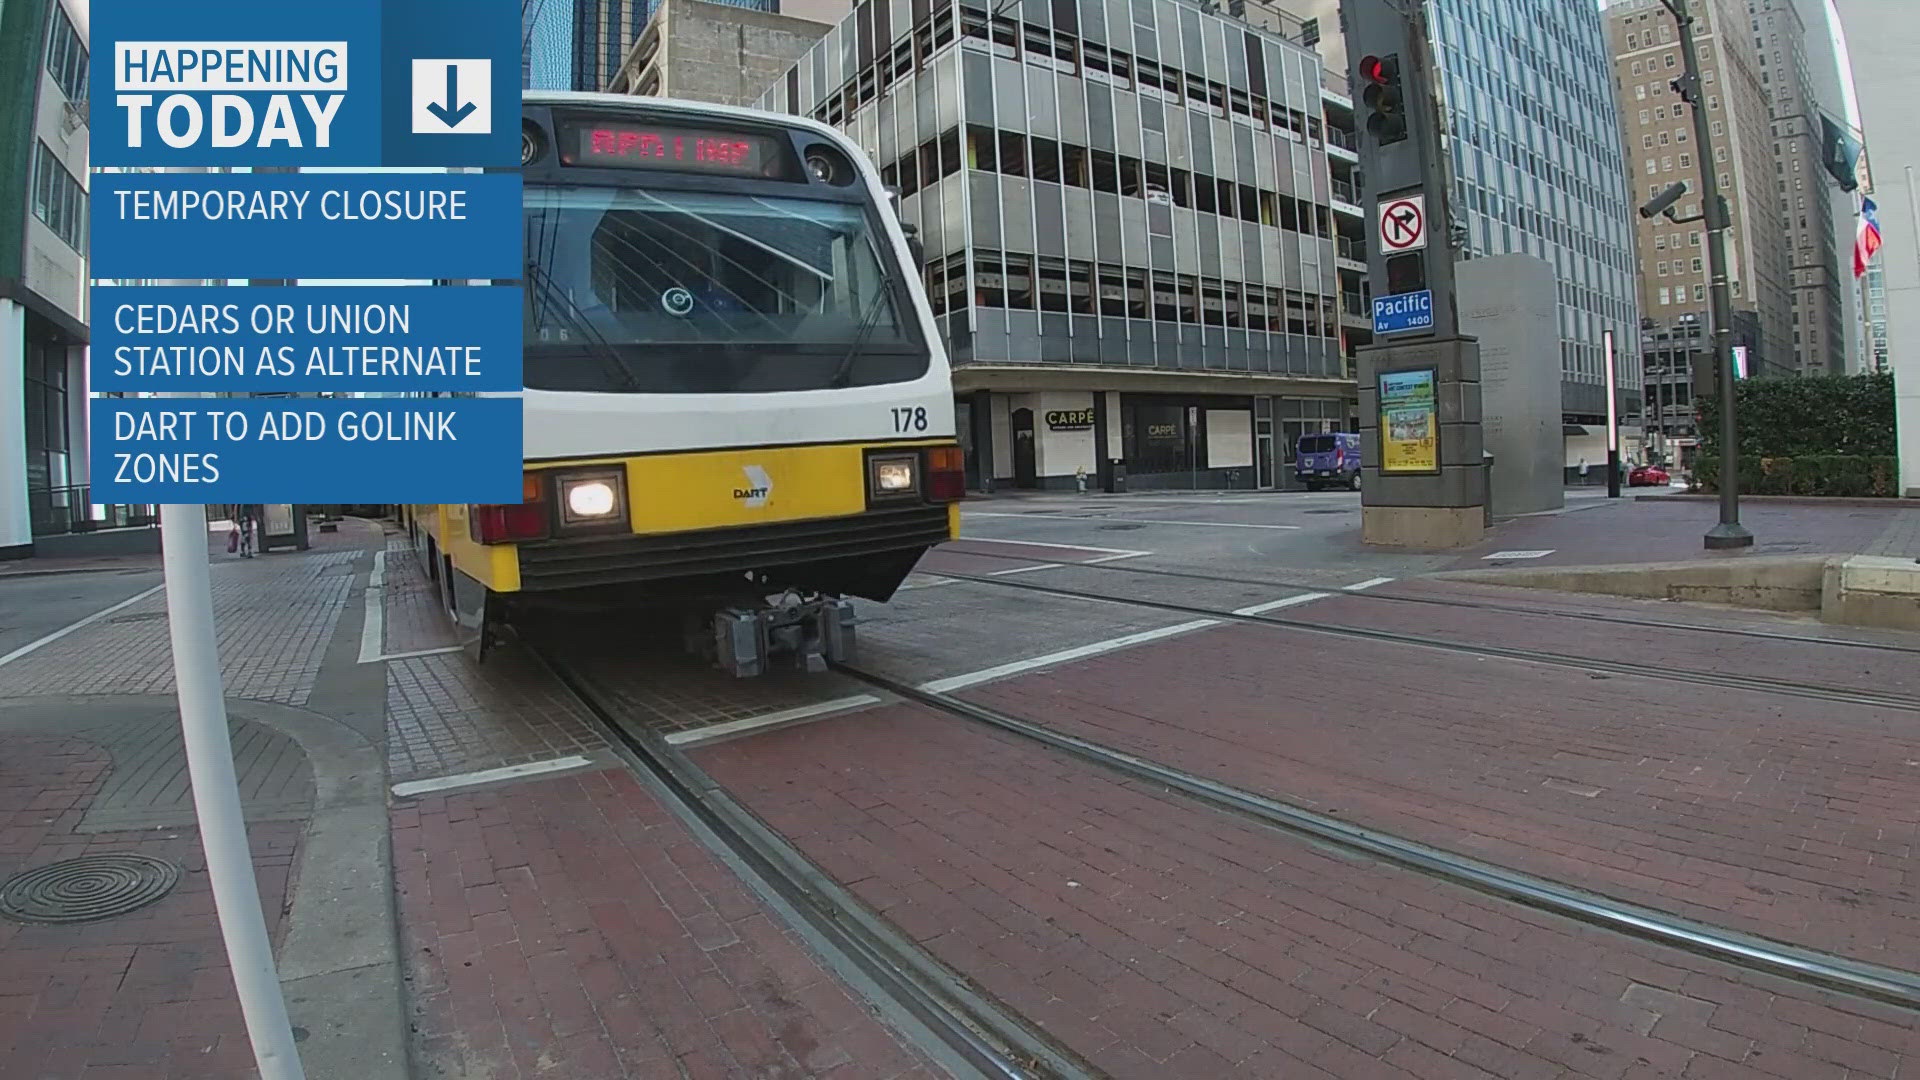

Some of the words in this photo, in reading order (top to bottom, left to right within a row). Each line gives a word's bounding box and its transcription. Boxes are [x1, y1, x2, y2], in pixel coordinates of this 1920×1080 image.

[1375, 294, 1429, 317] Pacific
[1377, 321, 1389, 331] Av
[1407, 315, 1430, 326] 1400
[890, 406, 928, 432] 178
[1048, 409, 1095, 425] CARPÉ
[733, 487, 768, 498] DART
